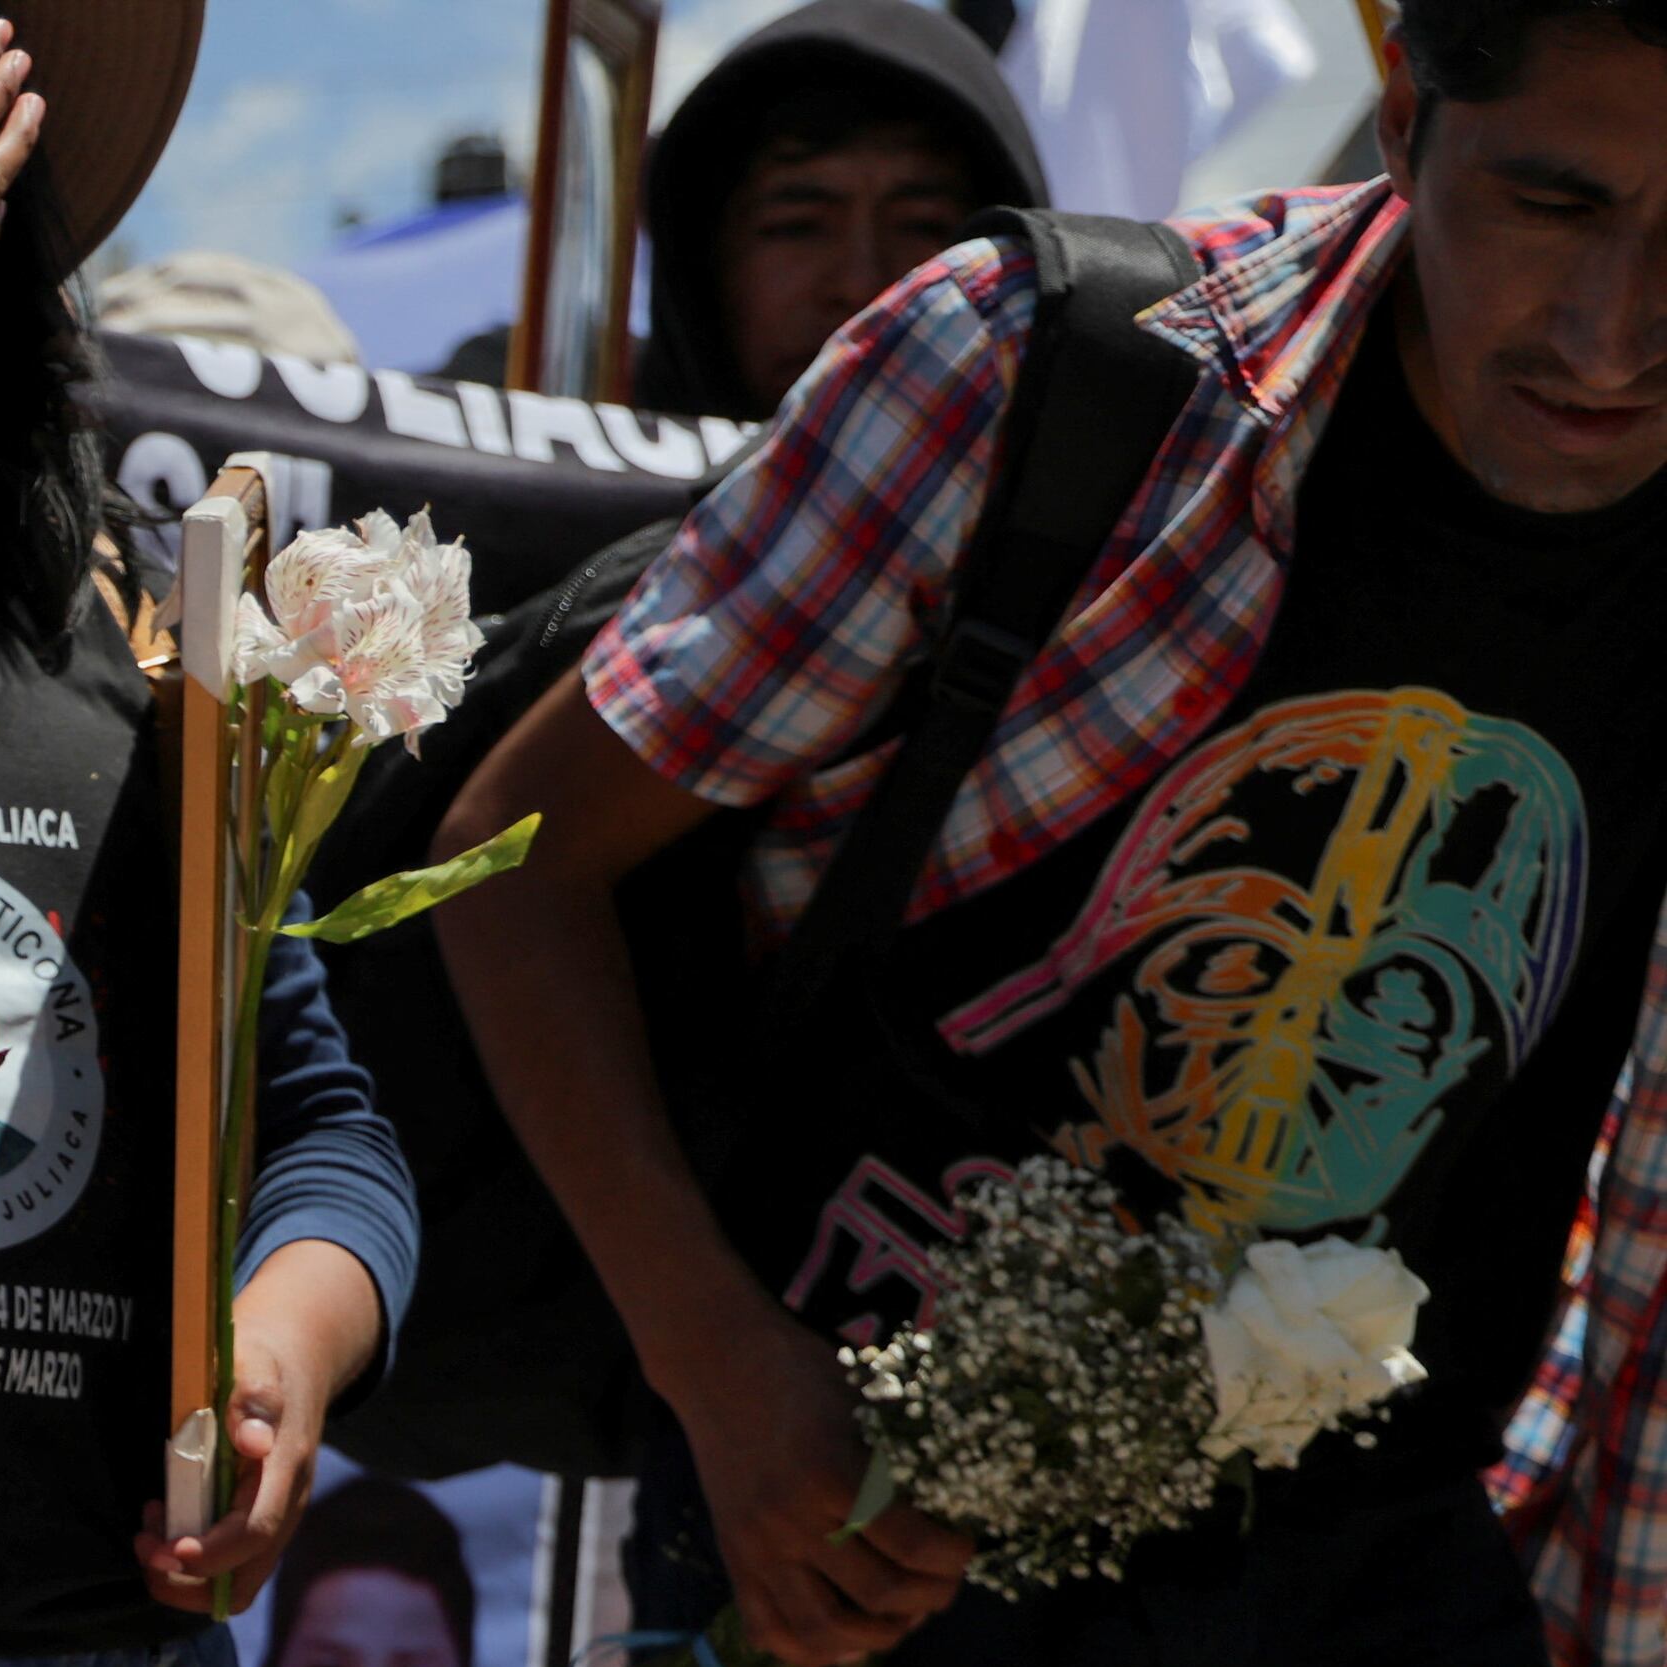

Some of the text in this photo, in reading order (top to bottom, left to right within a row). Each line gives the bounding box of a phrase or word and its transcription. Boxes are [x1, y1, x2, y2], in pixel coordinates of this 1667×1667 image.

[3, 1110, 87, 1220] JULIACA
[13, 1285, 43, 1333] DE
[47, 1287, 117, 1340] MARZO
[3, 1347, 83, 1400] MARZO
